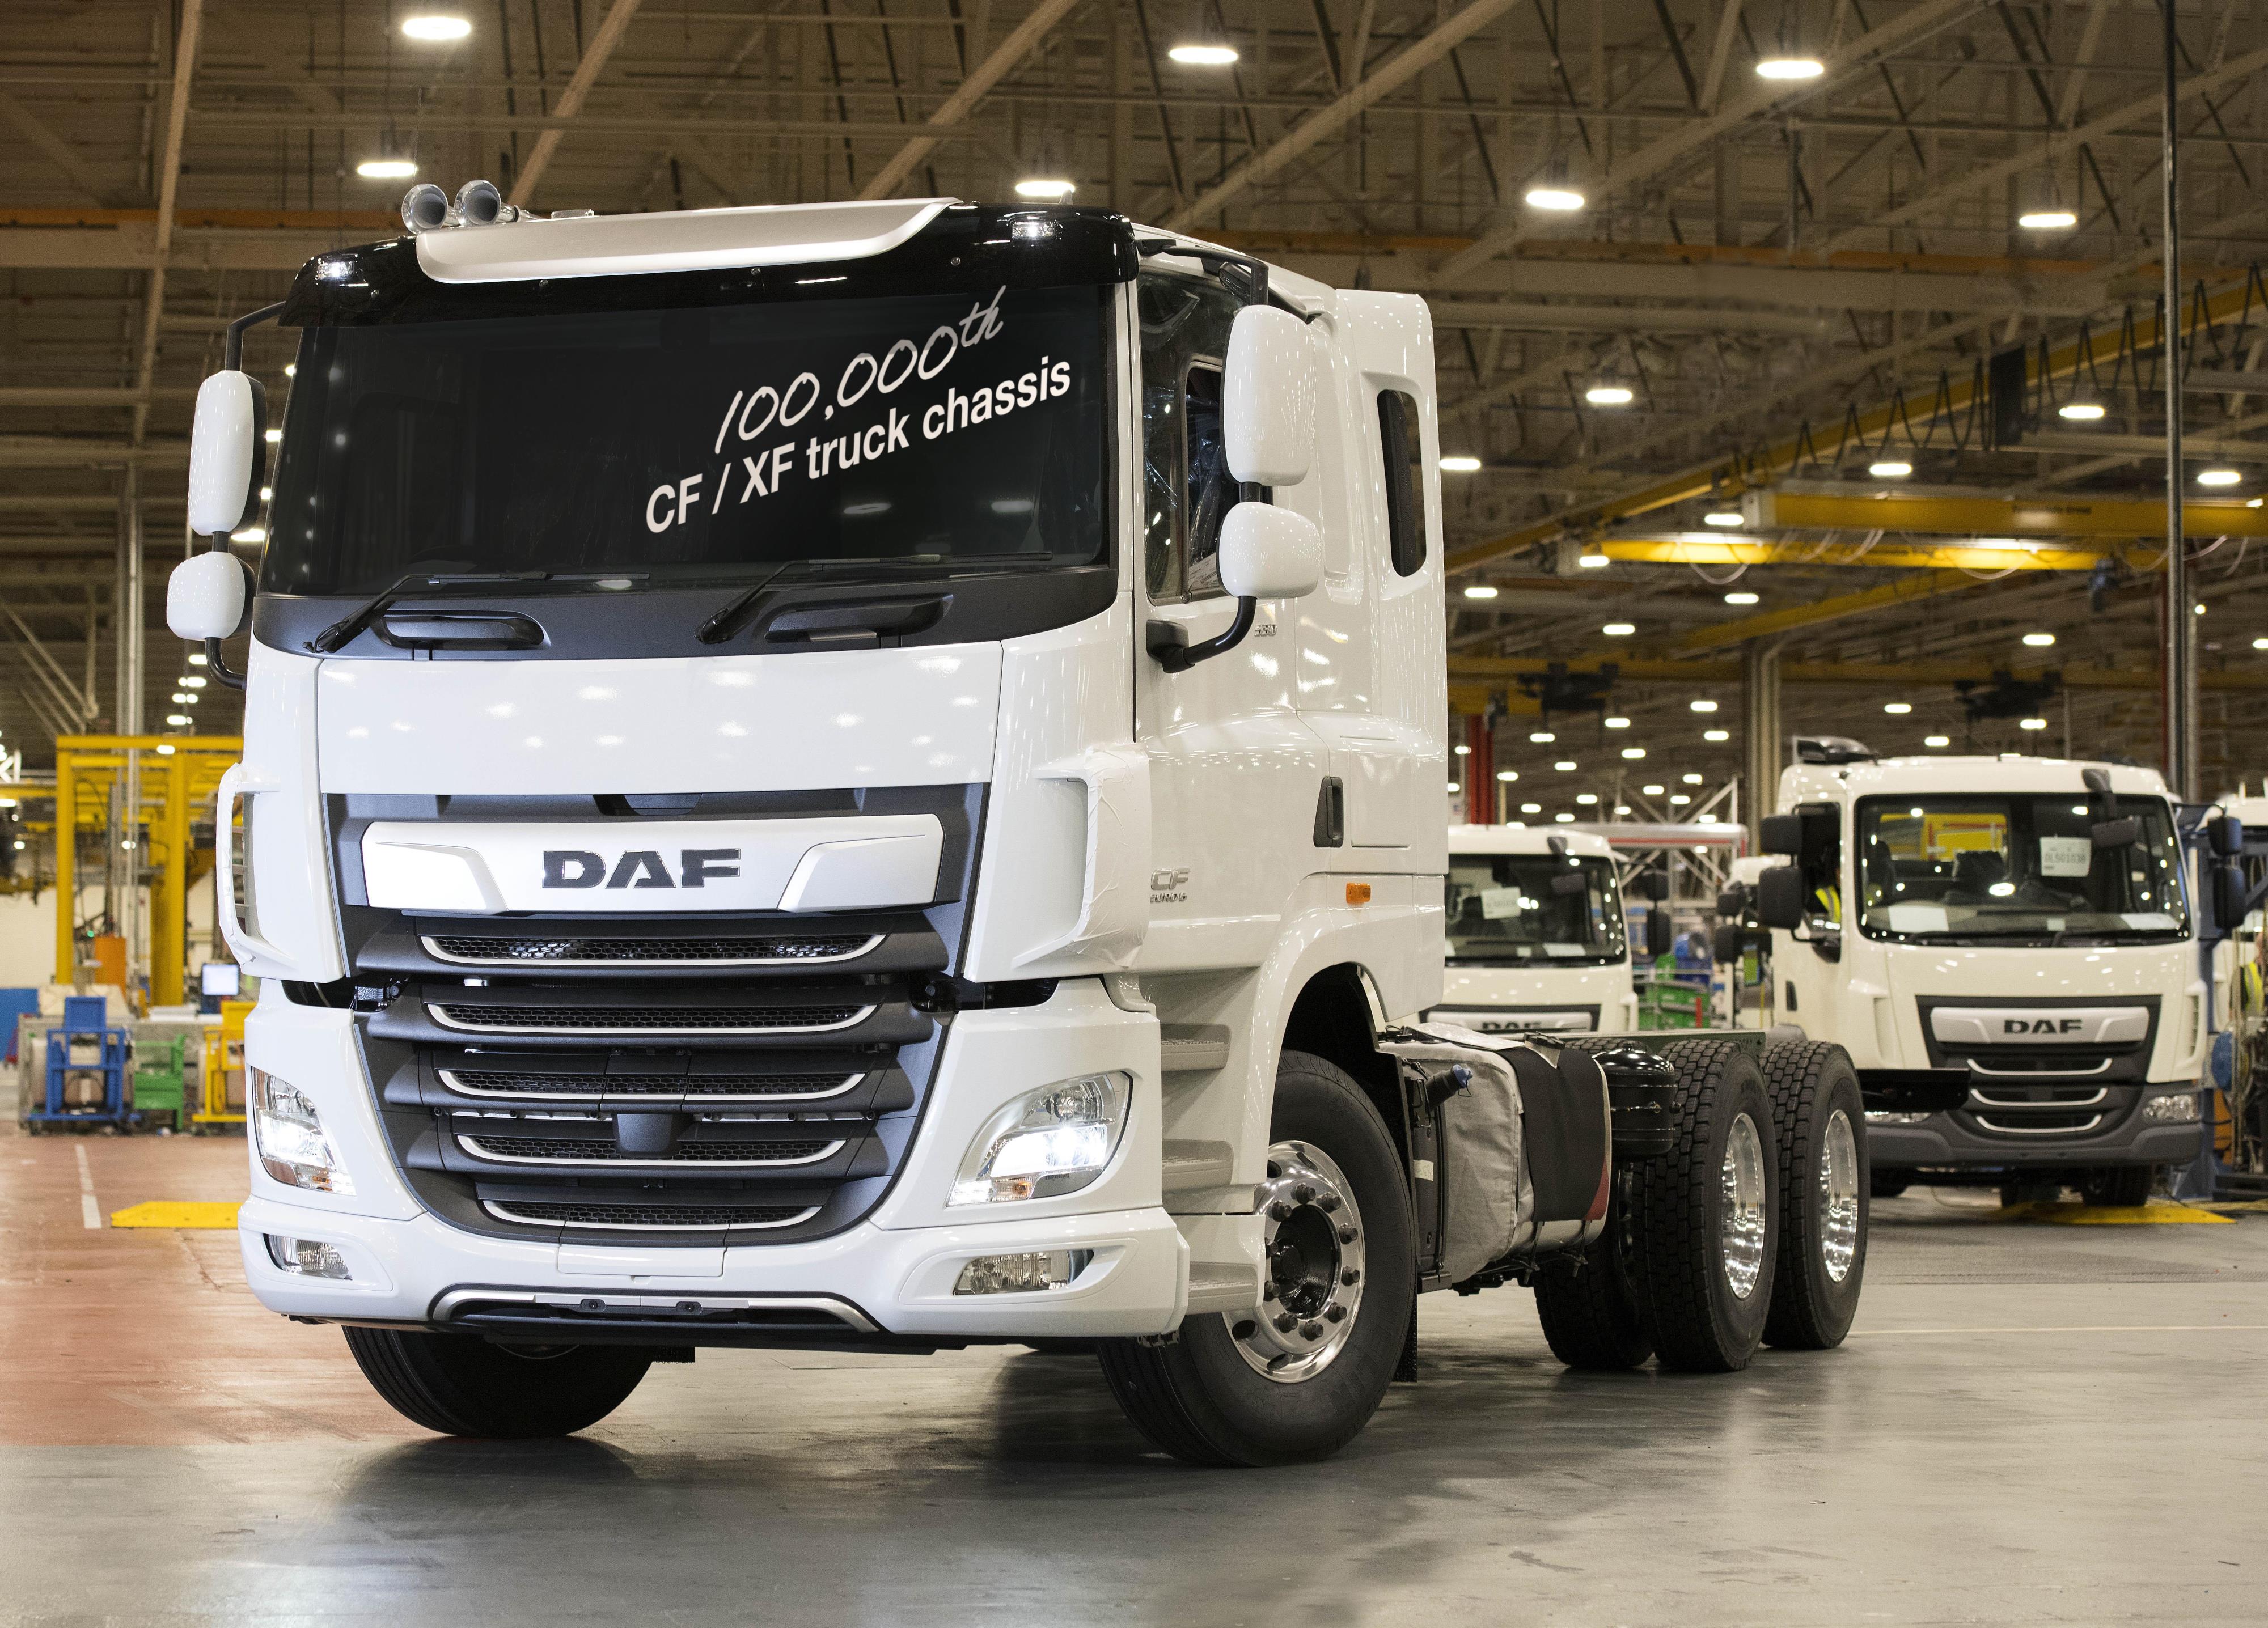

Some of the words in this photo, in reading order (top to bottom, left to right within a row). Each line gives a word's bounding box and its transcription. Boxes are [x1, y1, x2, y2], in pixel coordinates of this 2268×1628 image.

[714, 285, 1006, 455] 100,000th
[646, 473, 703, 533] CF
[712, 463, 731, 515] /
[739, 442, 796, 504] XF
[806, 405, 910, 480] truck
[923, 357, 1070, 440] chassis
[542, 847, 741, 889] DAF
[1150, 868, 1191, 891] CF
[2004, 1019, 2083, 1034] DAF
